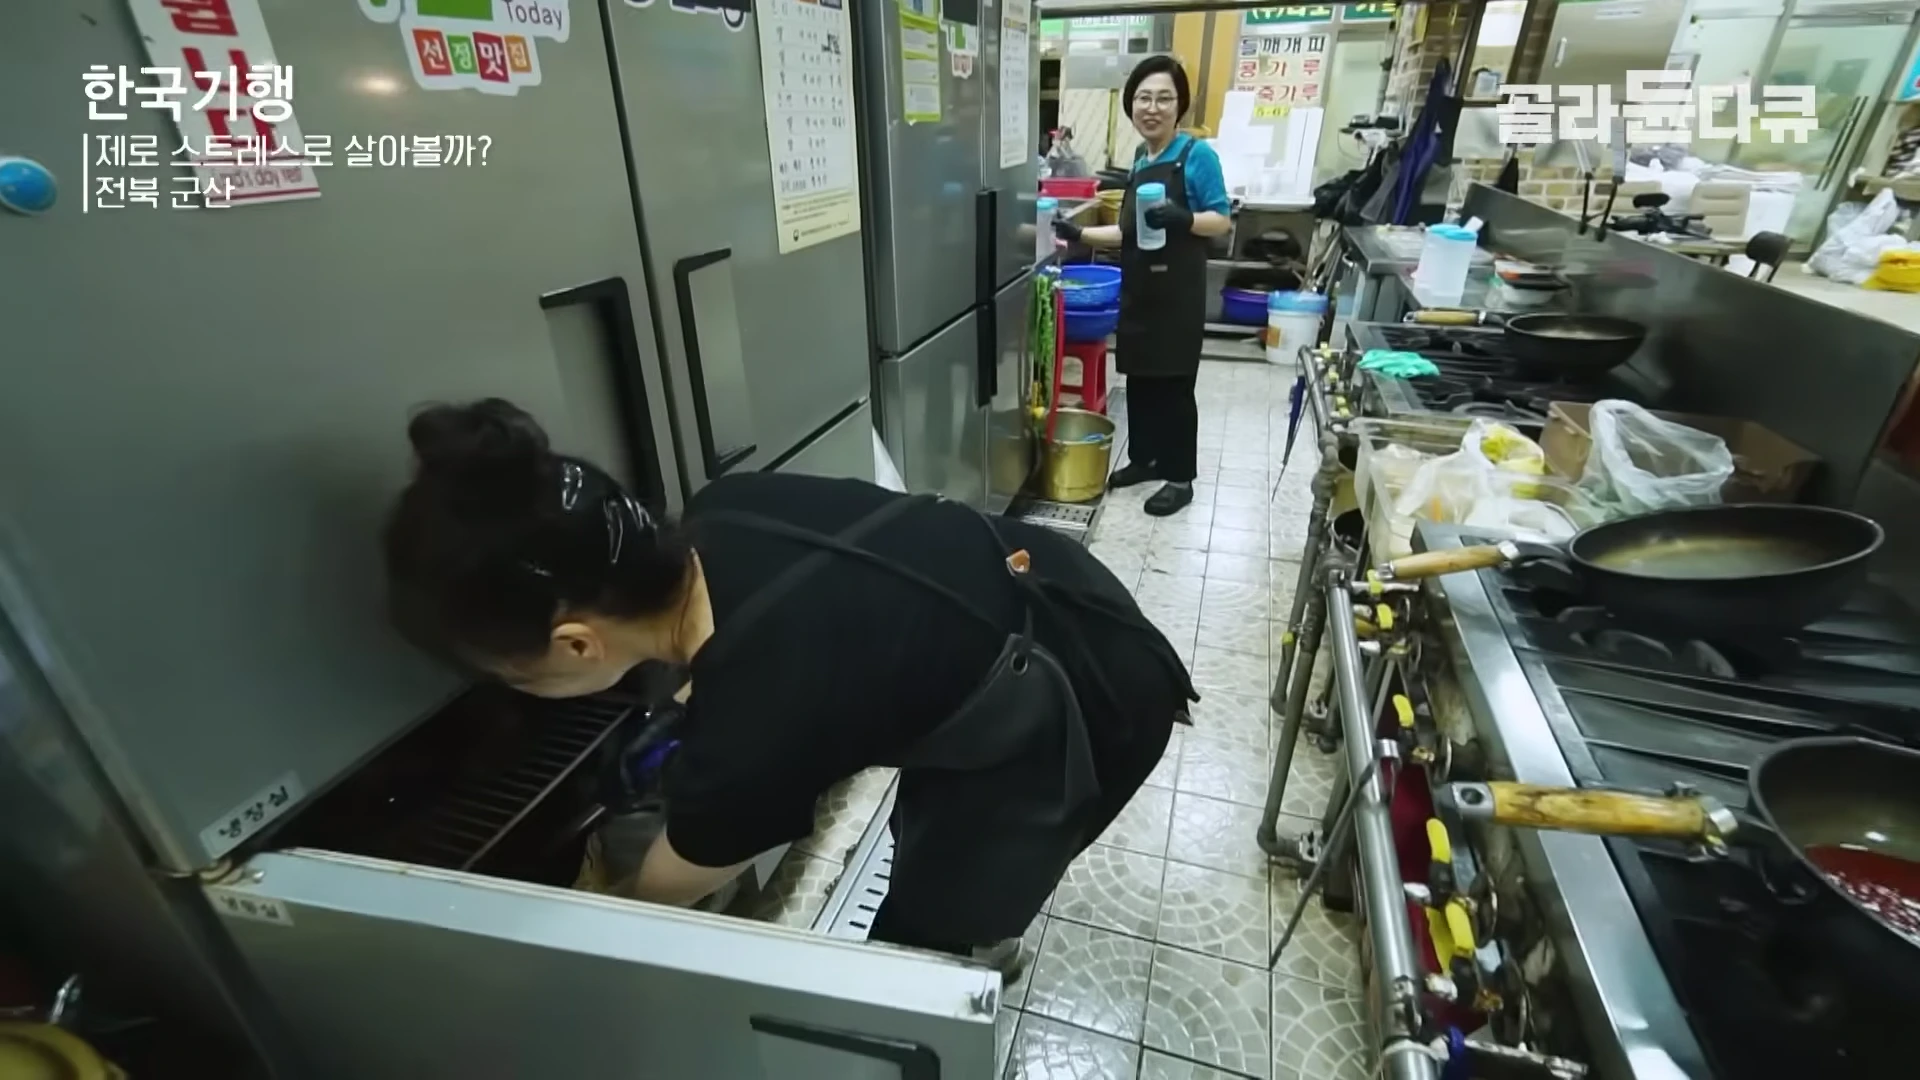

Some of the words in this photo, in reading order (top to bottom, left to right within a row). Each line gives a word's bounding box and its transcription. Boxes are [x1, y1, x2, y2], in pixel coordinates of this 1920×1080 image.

[502, 0, 563, 30] Today
[418, 35, 530, 79] 선정맛집
[219, 786, 288, 838] 냉장실
